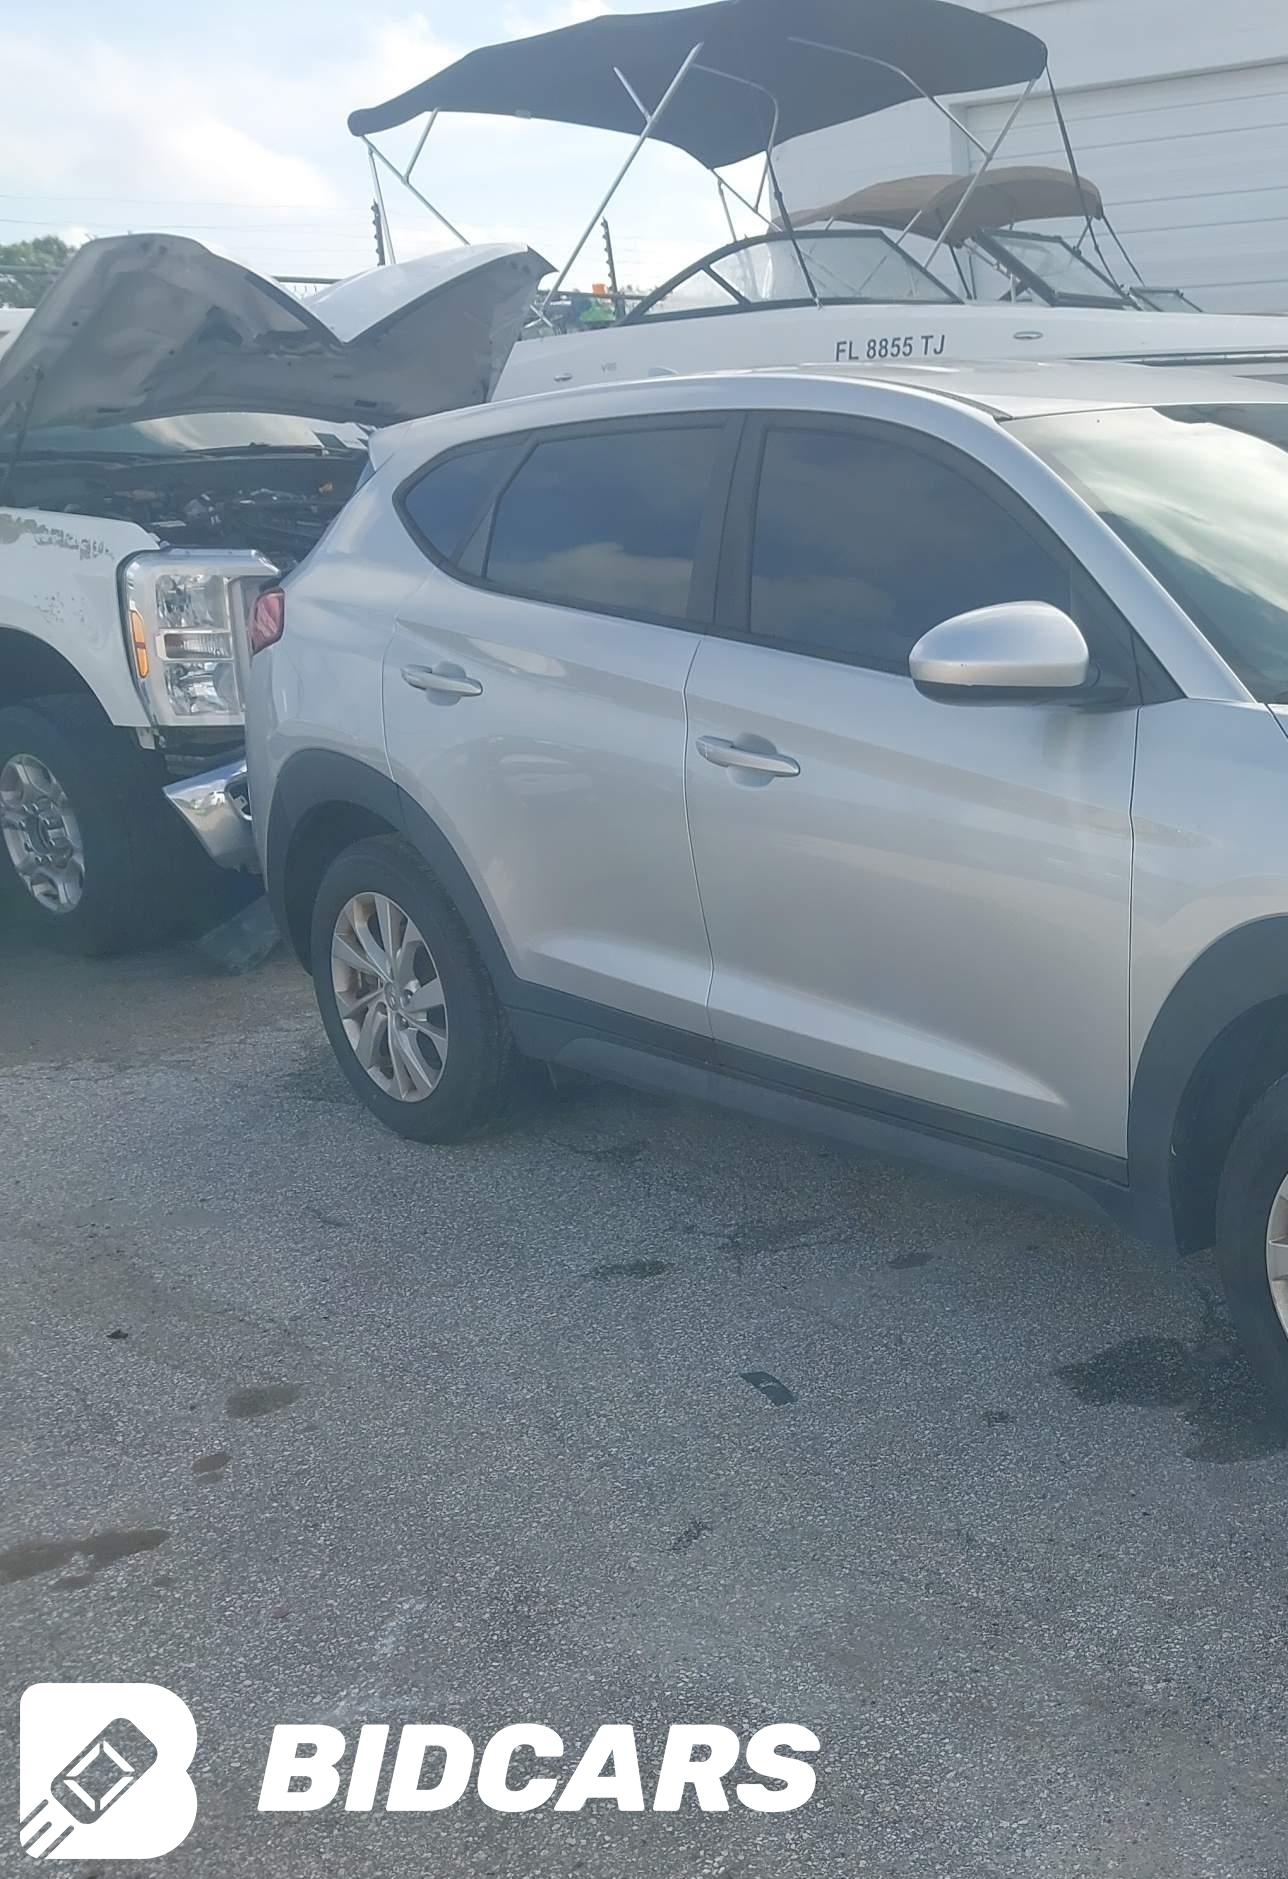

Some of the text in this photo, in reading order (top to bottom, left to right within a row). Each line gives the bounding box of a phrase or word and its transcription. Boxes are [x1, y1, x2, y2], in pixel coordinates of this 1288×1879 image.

[835, 334, 946, 362] FL 8855 TJ
